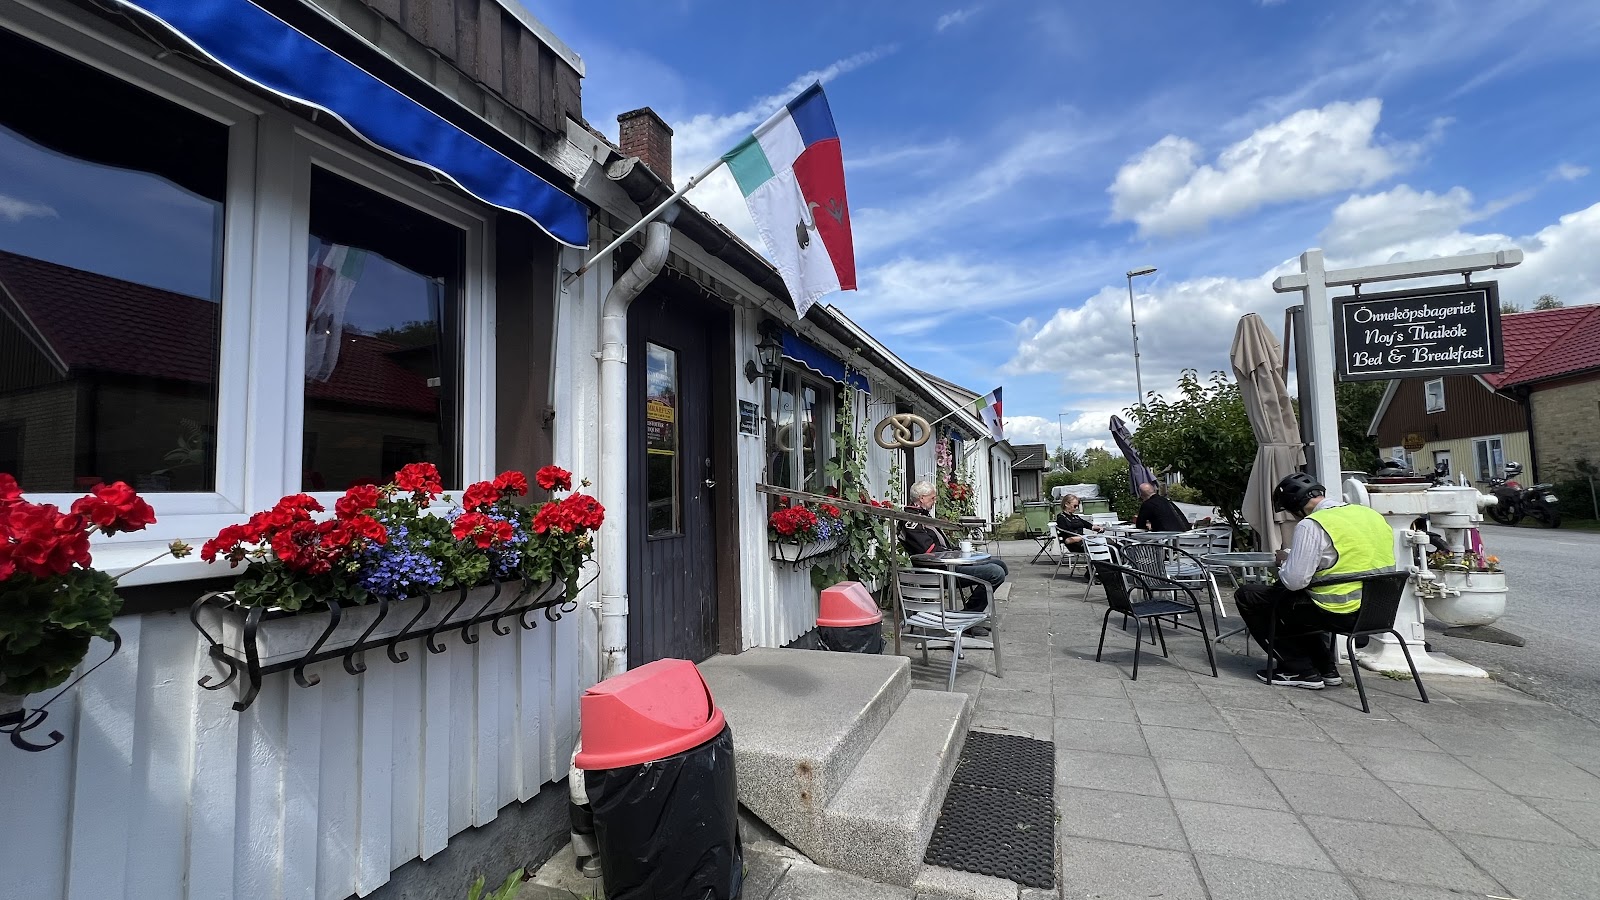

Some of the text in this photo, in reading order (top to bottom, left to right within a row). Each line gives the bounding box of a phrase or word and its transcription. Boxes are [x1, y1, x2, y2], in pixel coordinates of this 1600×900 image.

[1354, 301, 1476, 323] Önneköpsbageriet
[1408, 323, 1467, 341] Thaikök
[1352, 345, 1485, 367] Bed & Breakfast
